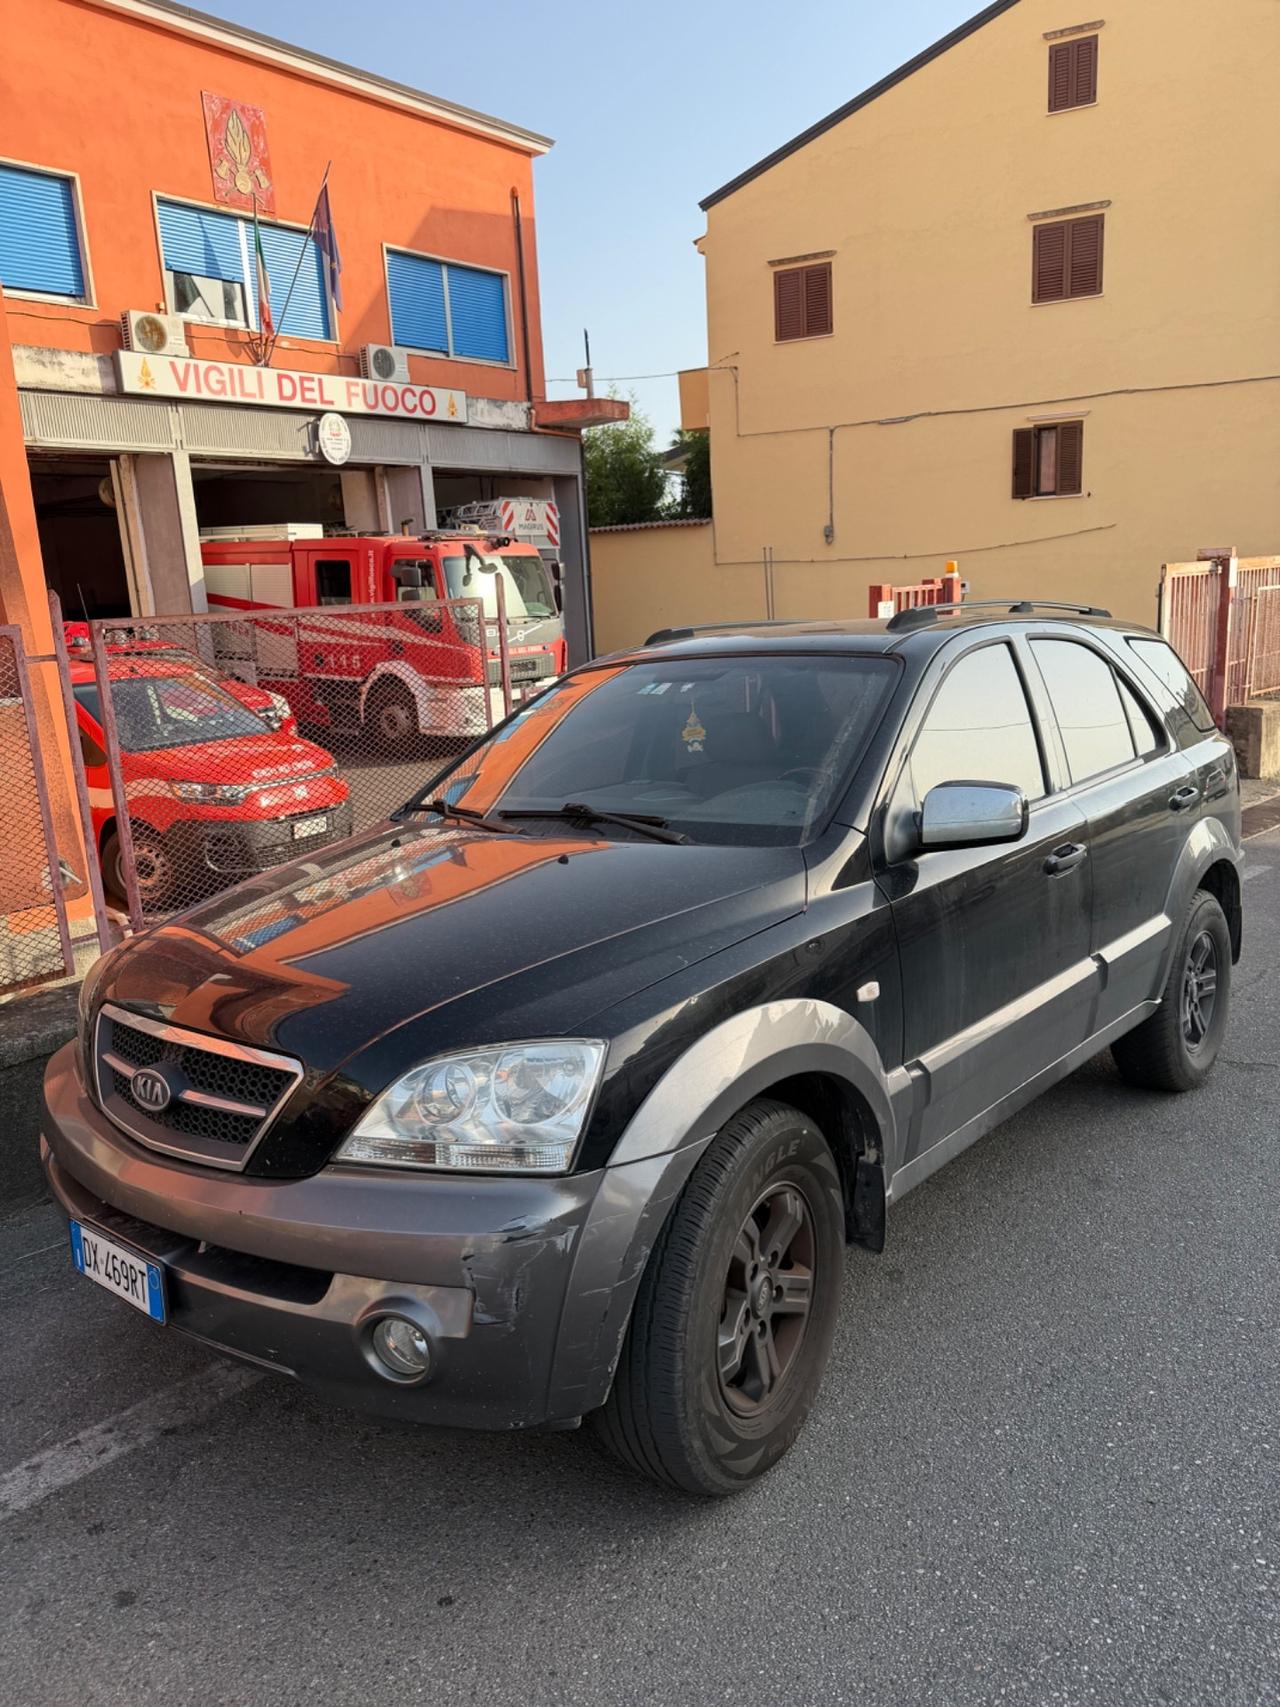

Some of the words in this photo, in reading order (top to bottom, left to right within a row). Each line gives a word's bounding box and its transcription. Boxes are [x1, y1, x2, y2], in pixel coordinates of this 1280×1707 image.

[168, 361, 265, 399] VIGILI
[276, 373, 335, 406] DEL
[345, 380, 437, 416] FUOCO
[135, 1075, 164, 1105] KIA
[83, 1236, 100, 1275] DX
[104, 1250, 147, 1304] 469RT
